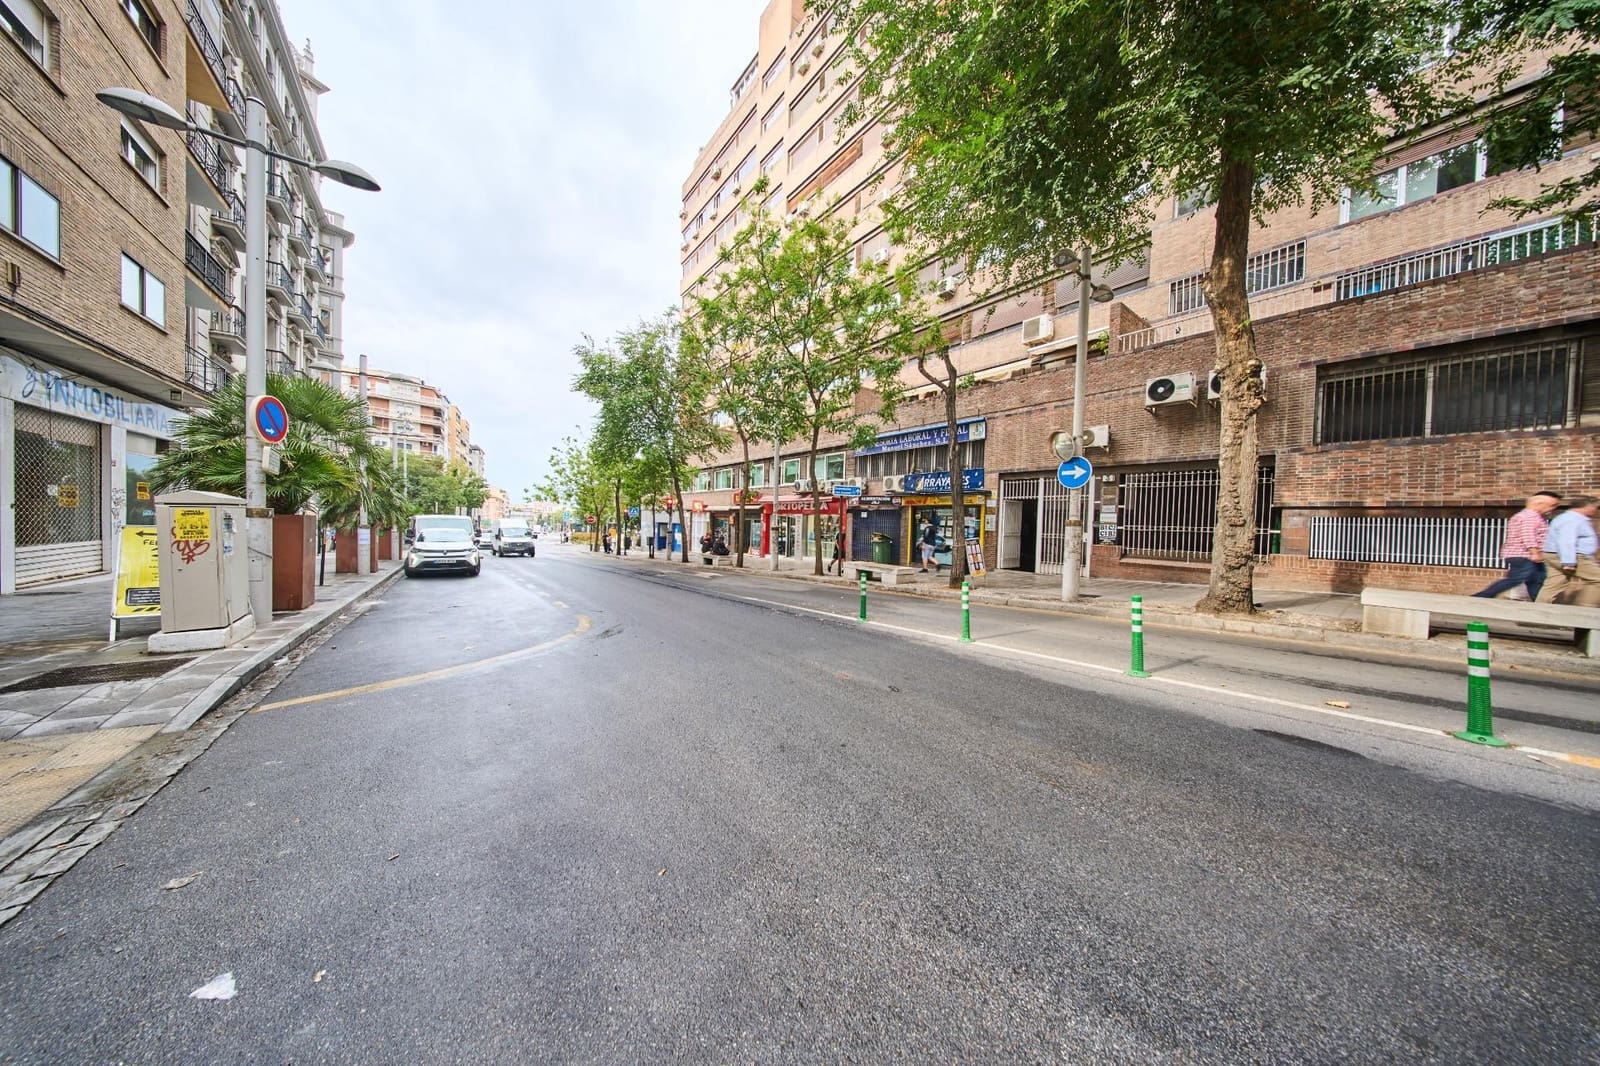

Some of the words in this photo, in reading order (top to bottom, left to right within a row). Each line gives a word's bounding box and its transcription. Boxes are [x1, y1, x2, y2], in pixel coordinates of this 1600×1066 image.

[899, 432, 931, 444] LABORAL
[933, 430, 940, 438] Y
[940, 425, 968, 437] FIAL
[916, 475, 970, 491] ARRAYAS
